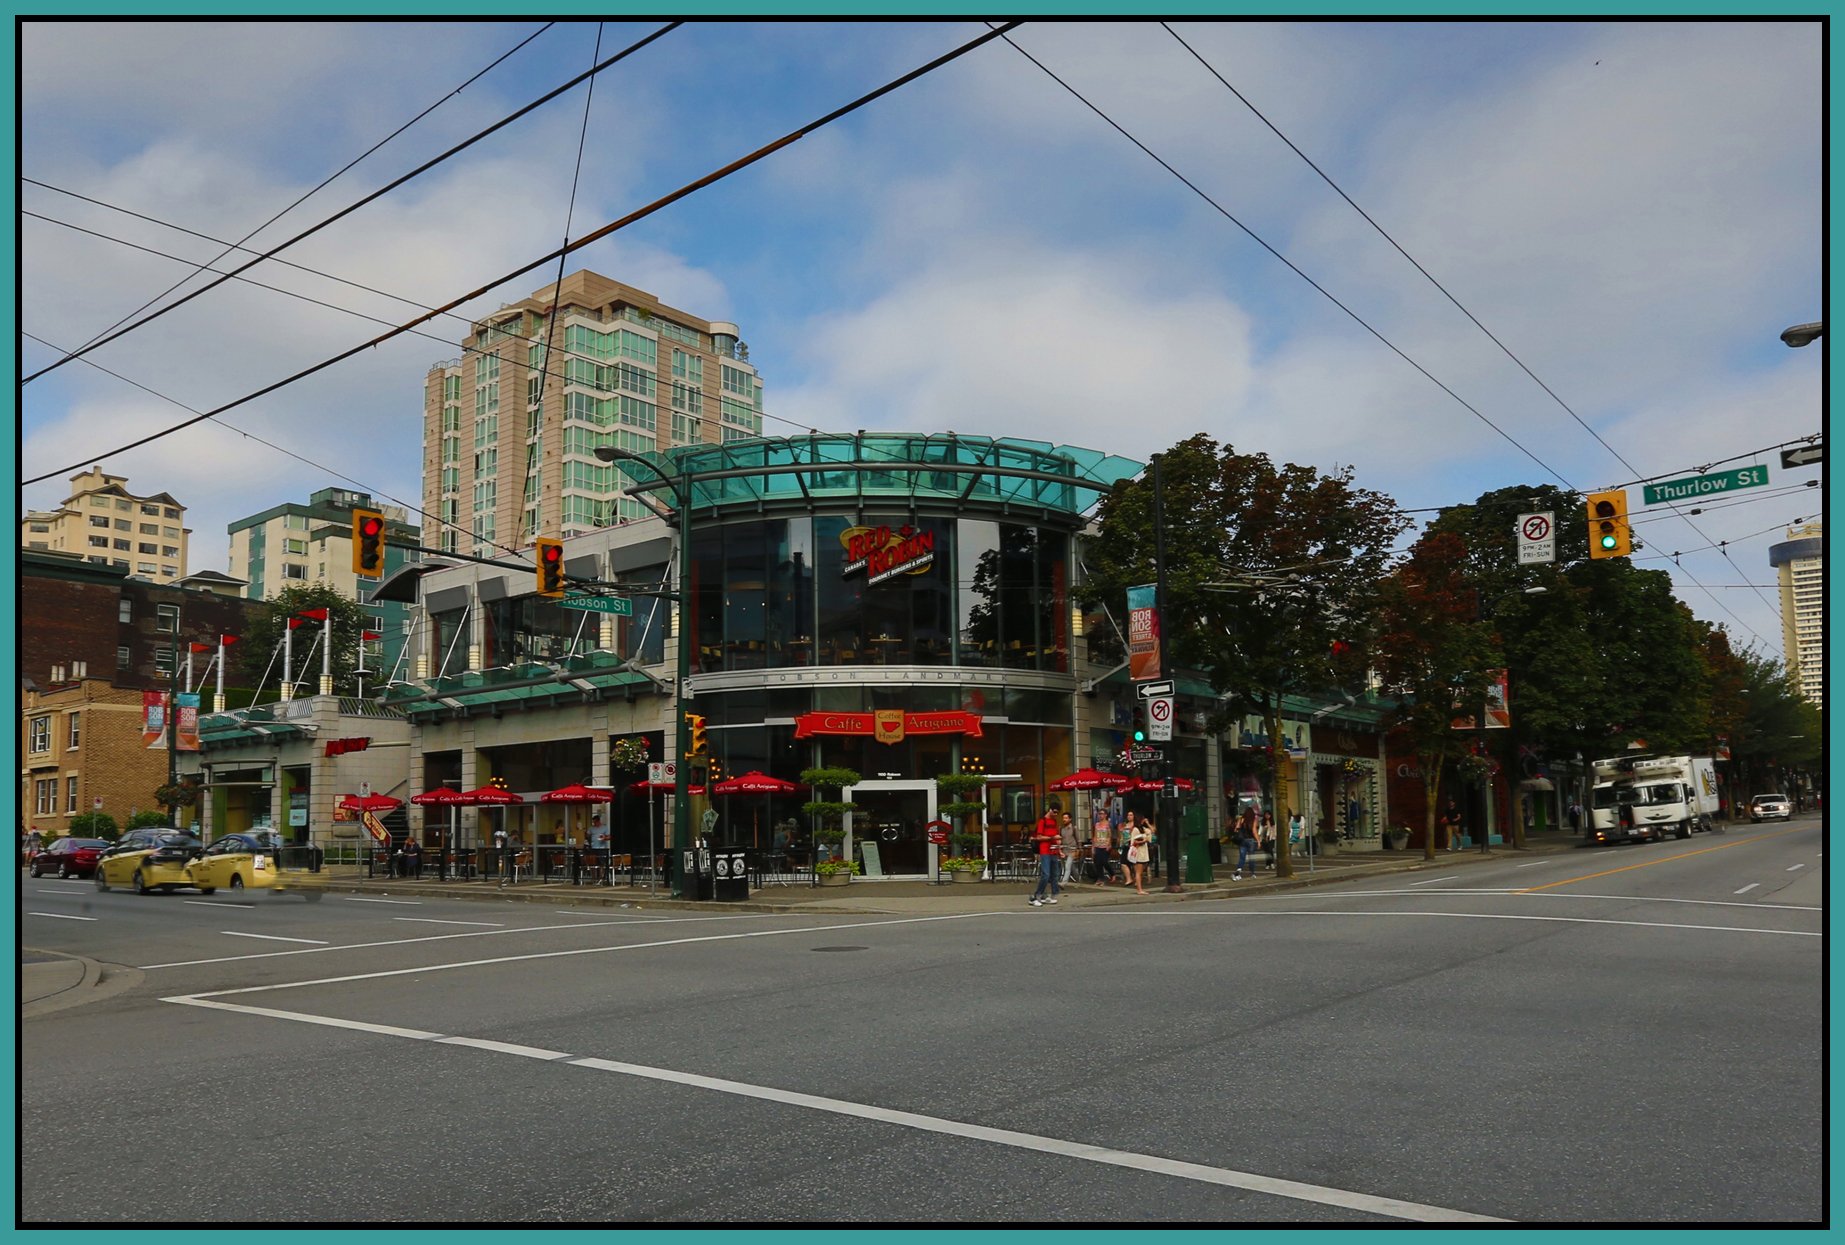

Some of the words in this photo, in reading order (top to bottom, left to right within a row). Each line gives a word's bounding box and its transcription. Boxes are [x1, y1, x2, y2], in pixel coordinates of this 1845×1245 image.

[1653, 478, 1728, 500] Thurlow
[1737, 470, 1760, 486] St
[848, 526, 890, 564] RED
[869, 528, 934, 577] ROBIN
[613, 600, 626, 611] St
[763, 671, 857, 683] ROBSON
[884, 672, 1008, 682] LANDMARK
[909, 716, 964, 730] Artigiano
